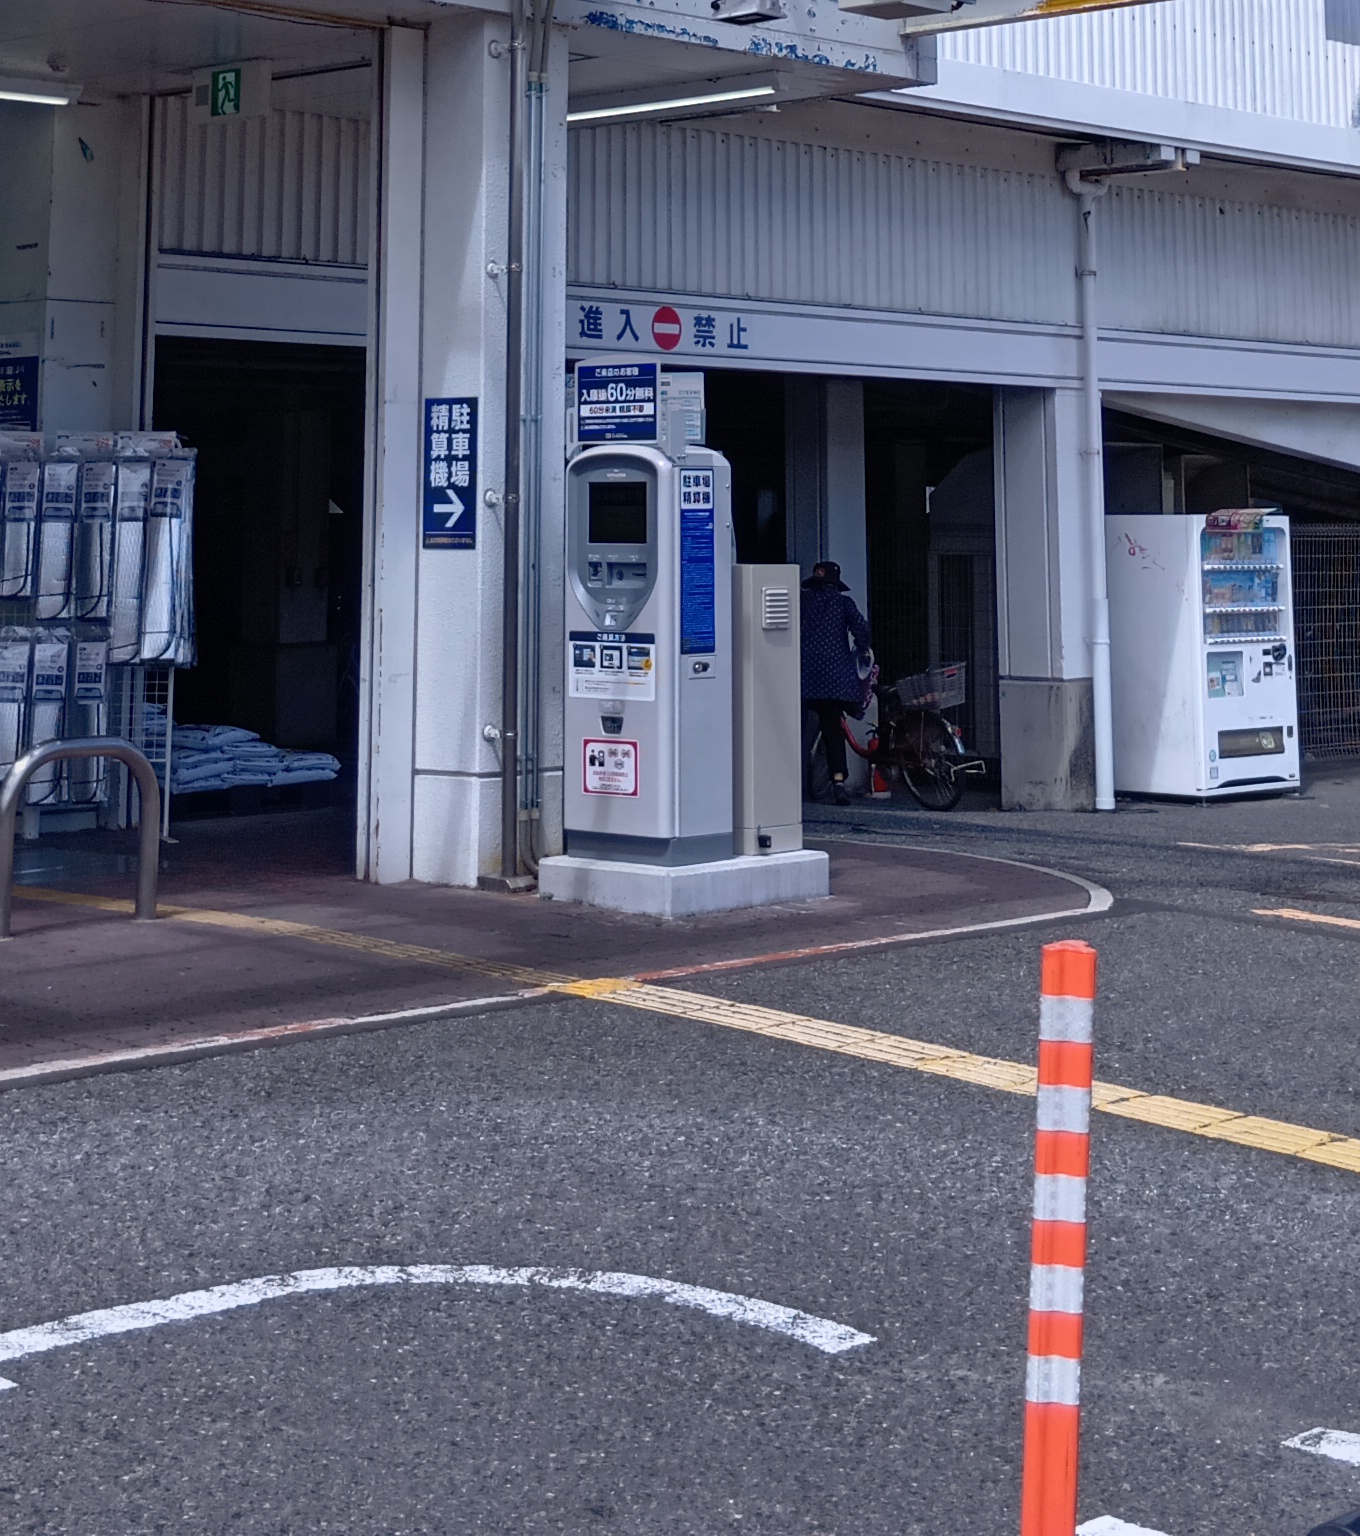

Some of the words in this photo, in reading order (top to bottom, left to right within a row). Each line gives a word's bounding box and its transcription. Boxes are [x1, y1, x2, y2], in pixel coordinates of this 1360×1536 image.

[579, 304, 640, 342] 進入
[693, 313, 749, 350] 禁止
[430, 403, 450, 487] 精算機
[451, 403, 471, 487] 駐車場
